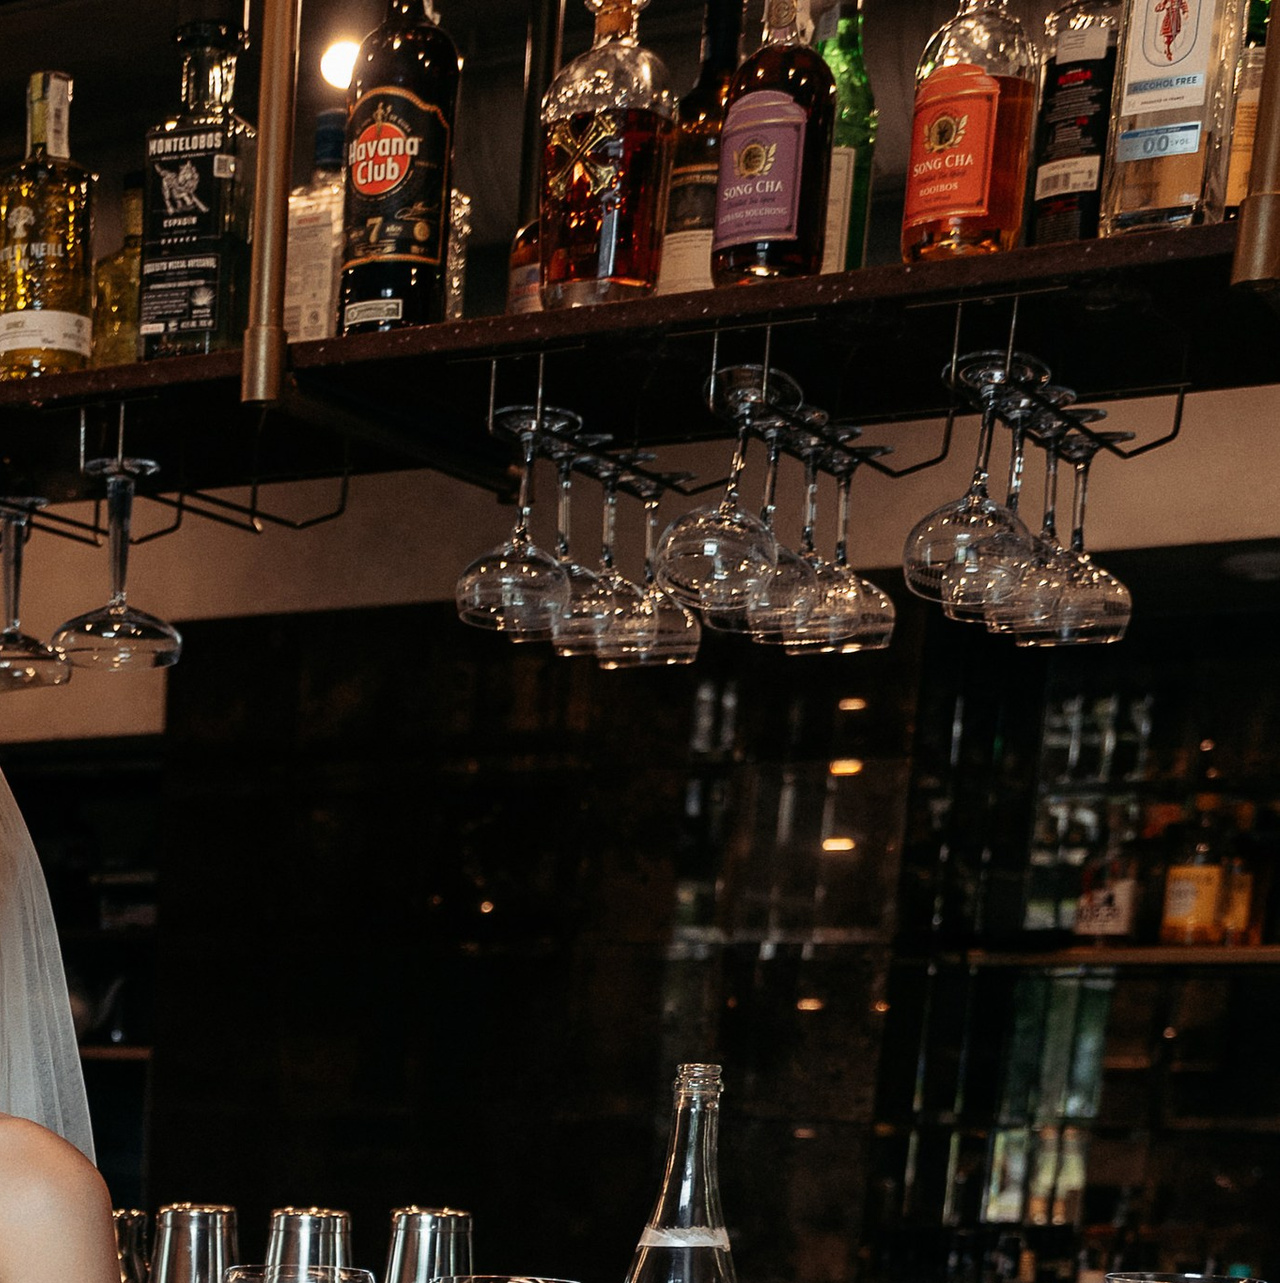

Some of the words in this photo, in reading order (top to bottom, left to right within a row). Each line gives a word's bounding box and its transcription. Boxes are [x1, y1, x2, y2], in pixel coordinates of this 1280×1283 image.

[1131, 80, 1174, 93] ALCOHOL
[1175, 75, 1198, 86] FREE
[148, 131, 223, 156] MONTELOBOS
[348, 137, 419, 166] Havana
[356, 157, 400, 185] Club
[913, 157, 942, 178] SONG
[944, 153, 975, 168] CHA
[723, 183, 753, 201] SONG
[755, 180, 784, 194] CHA
[365, 216, 384, 243] 7
